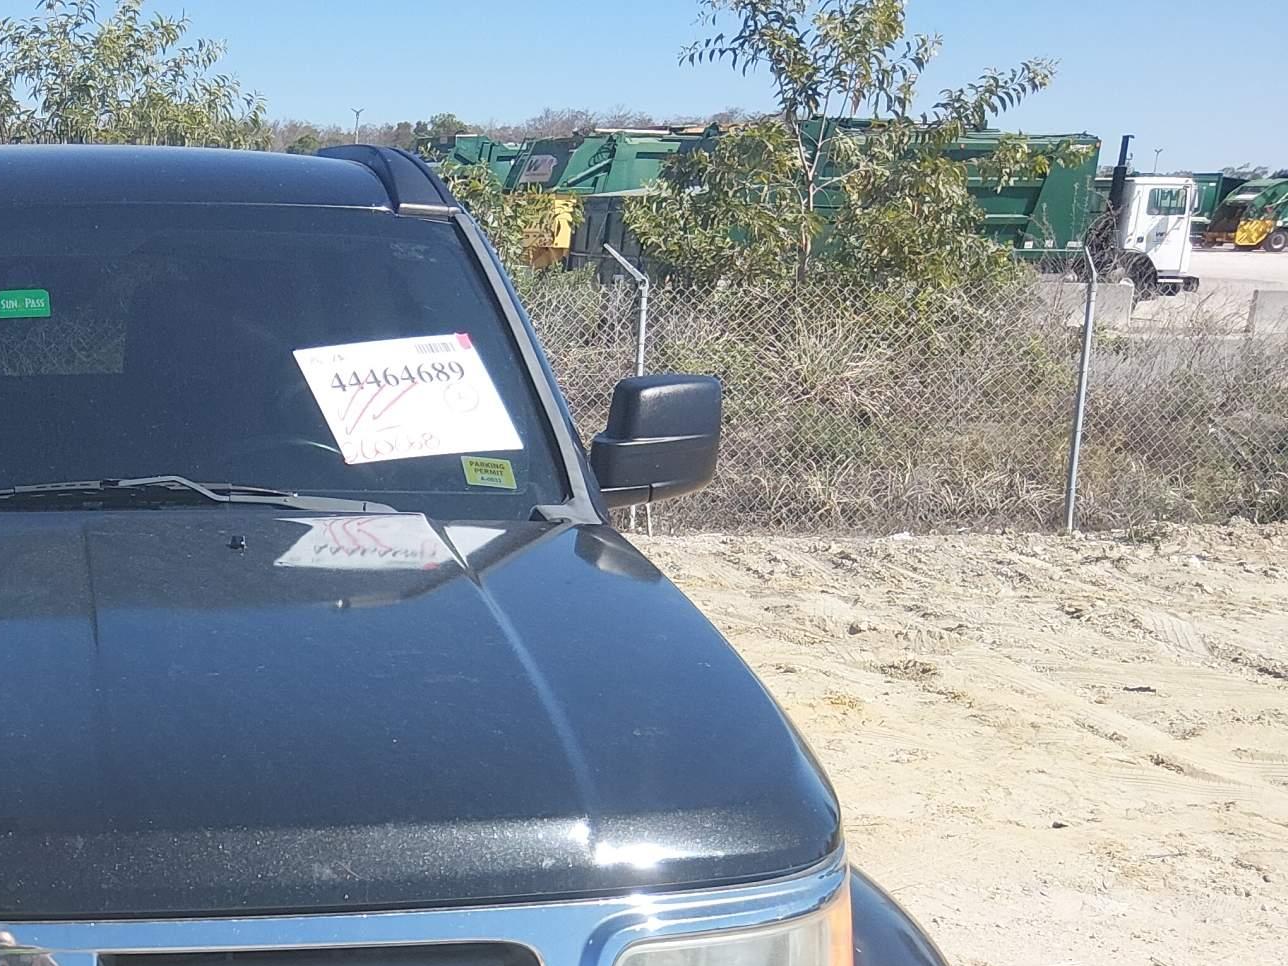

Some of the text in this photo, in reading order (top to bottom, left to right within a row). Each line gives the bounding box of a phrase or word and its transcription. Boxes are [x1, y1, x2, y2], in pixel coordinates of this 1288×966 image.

[24, 297, 45, 308] PASS
[330, 360, 465, 392] 44464689
[469, 460, 505, 470] PARKING
[474, 467, 504, 476] PERMIT
